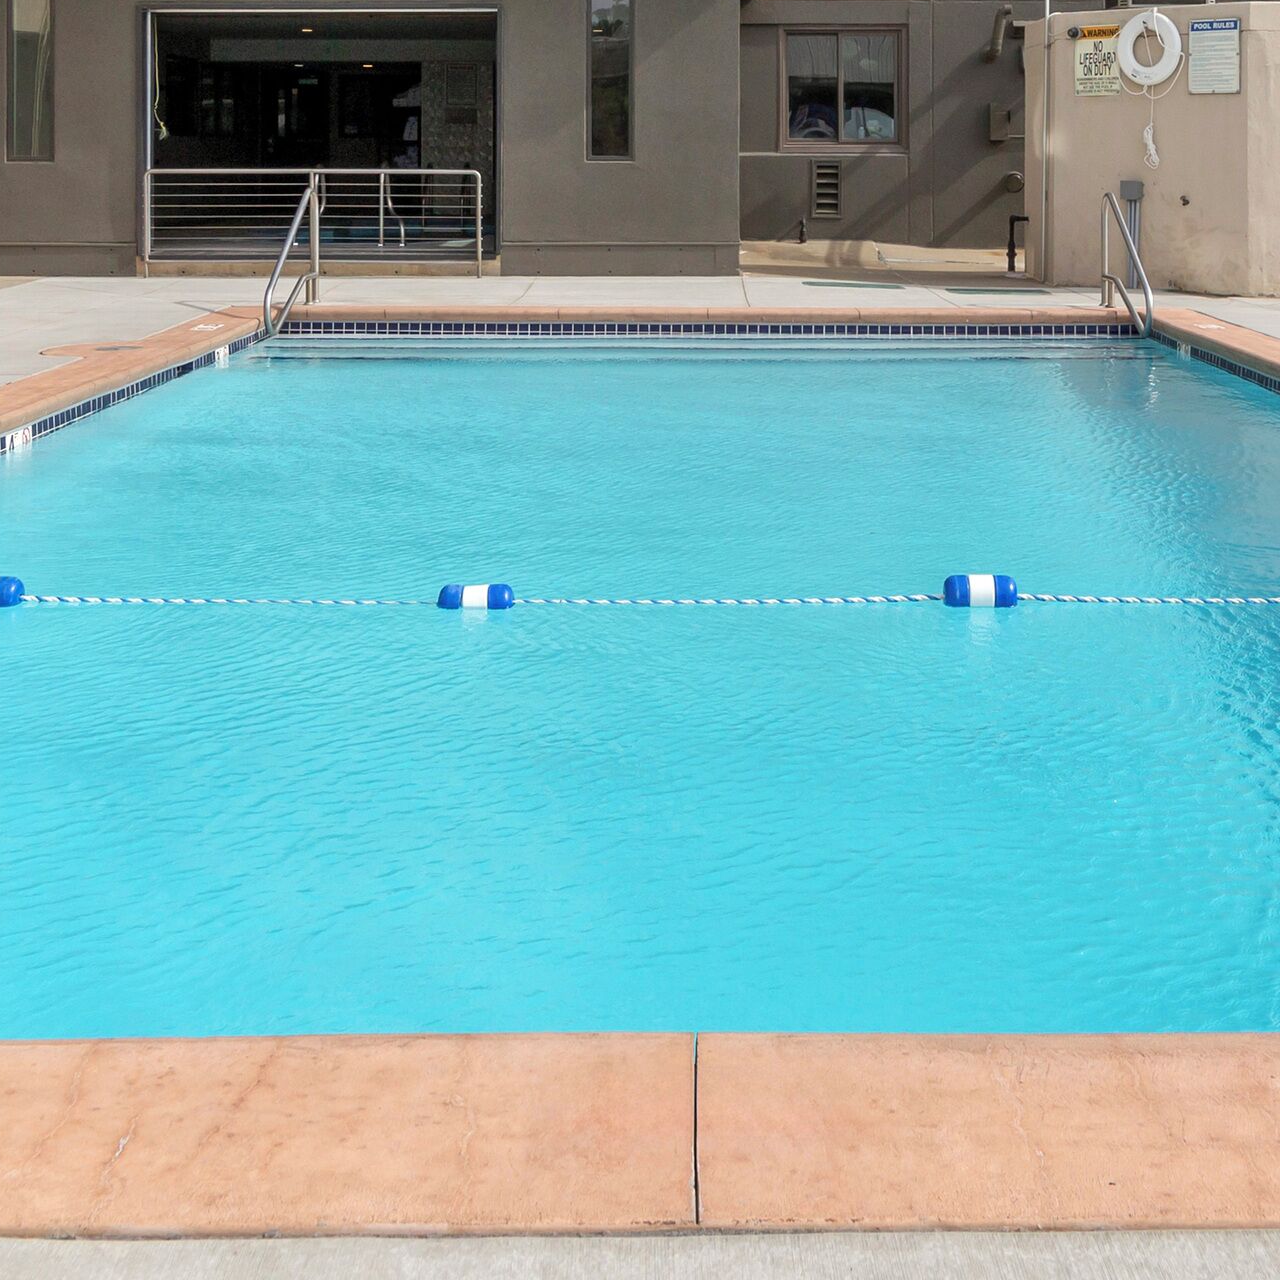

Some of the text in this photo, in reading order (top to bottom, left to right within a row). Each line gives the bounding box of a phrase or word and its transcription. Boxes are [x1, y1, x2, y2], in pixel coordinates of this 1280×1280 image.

[1213, 21, 1235, 29] RULES
[1087, 28, 1119, 38] WARNING
[1093, 40, 1103, 52] NO
[1080, 52, 1116, 65] LIFEGUARD
[1083, 64, 1112, 76] ON DUTY
